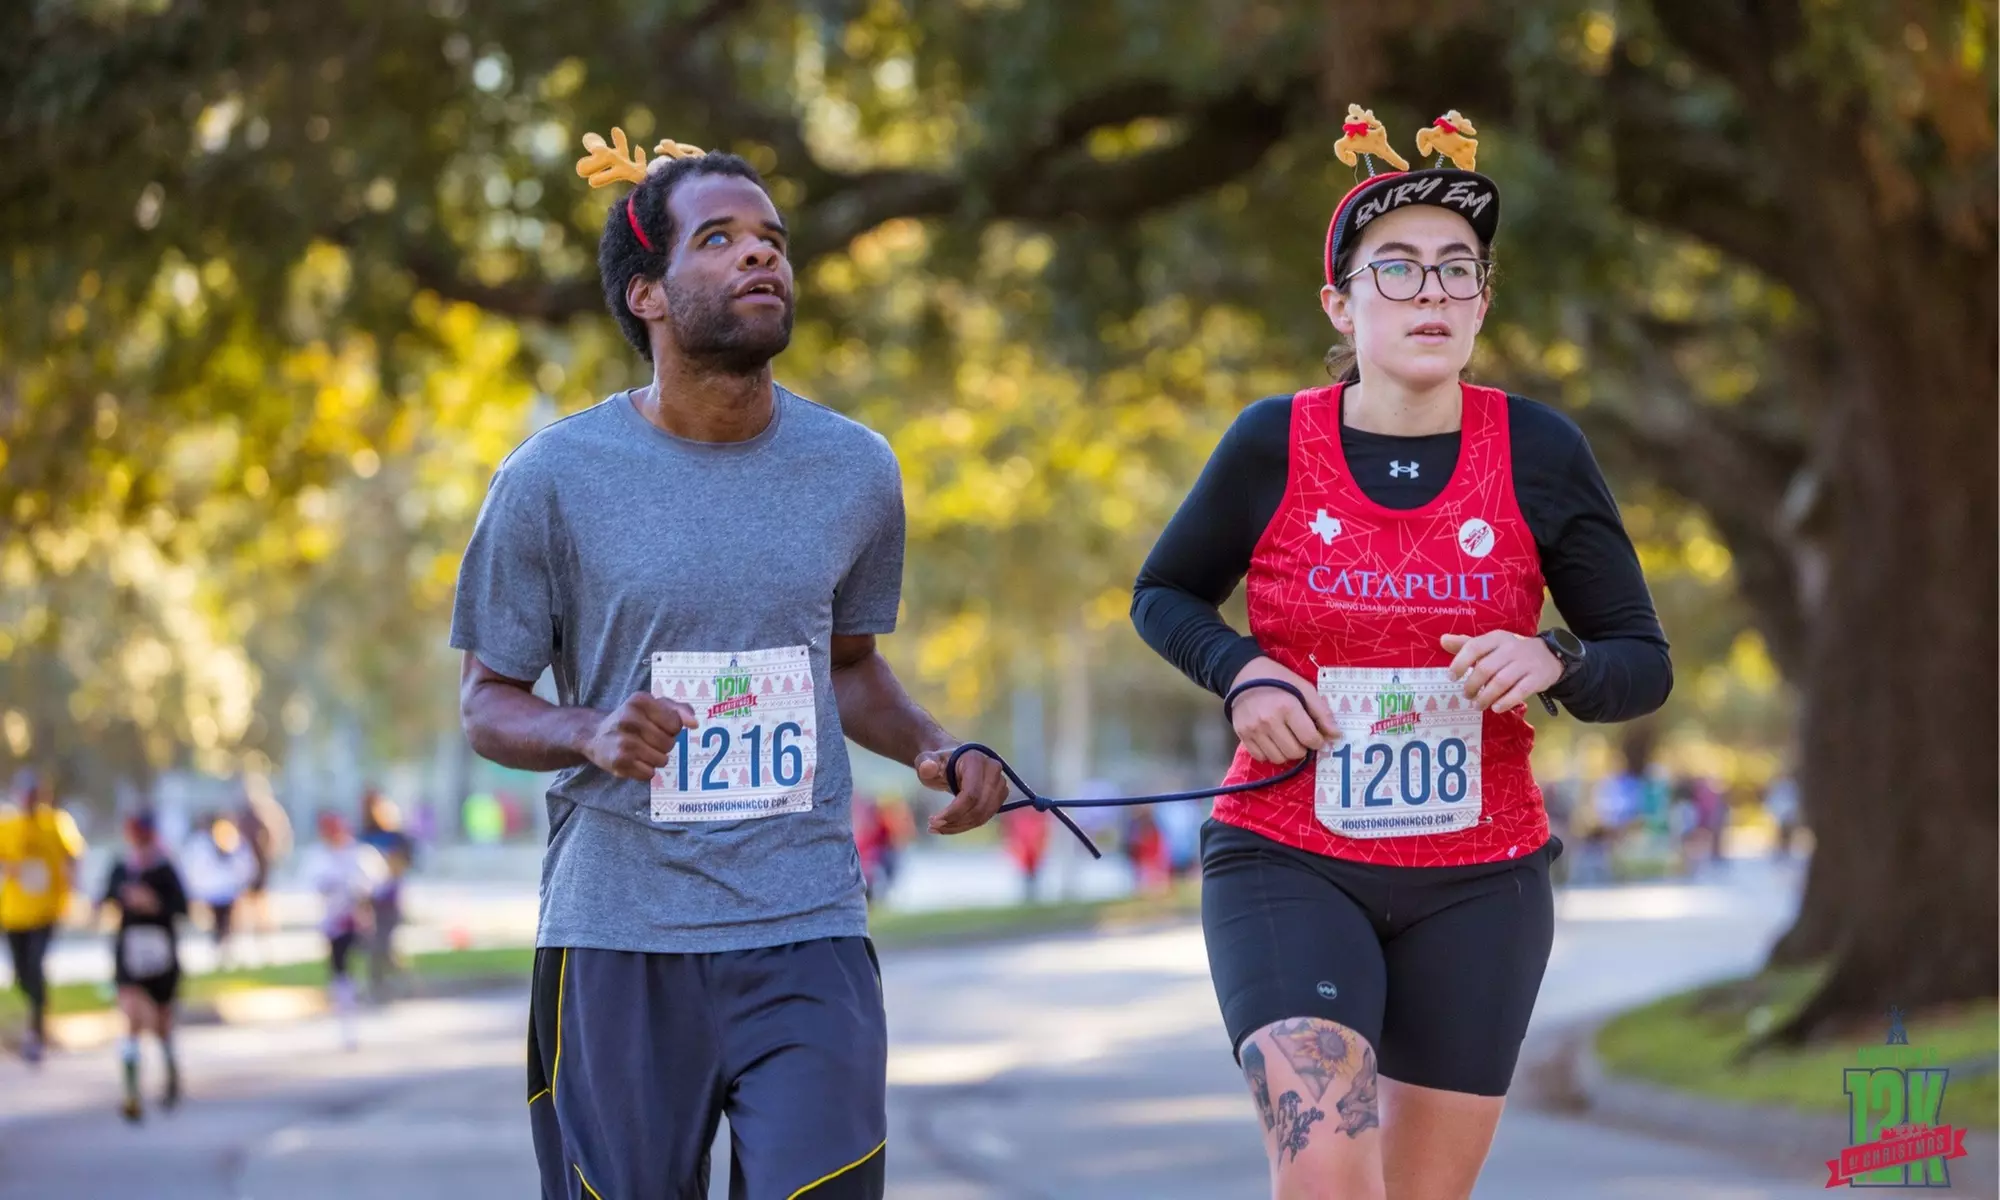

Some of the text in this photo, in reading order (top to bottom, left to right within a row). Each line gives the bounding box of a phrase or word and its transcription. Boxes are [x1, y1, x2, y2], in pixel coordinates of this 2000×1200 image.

[1441, 181, 1492, 219] EM
[1307, 565, 1495, 601] CATAPULT
[1325, 600, 1476, 615] TURNING DISABILITIES INTO CAPABILITIES
[714, 674, 752, 718] 12K
[1376, 691, 1416, 734] 12K
[676, 721, 803, 792] 1216
[1332, 737, 1468, 809] 1208
[1341, 813, 1454, 830] HOUSTONRUNNINGCO.COM
